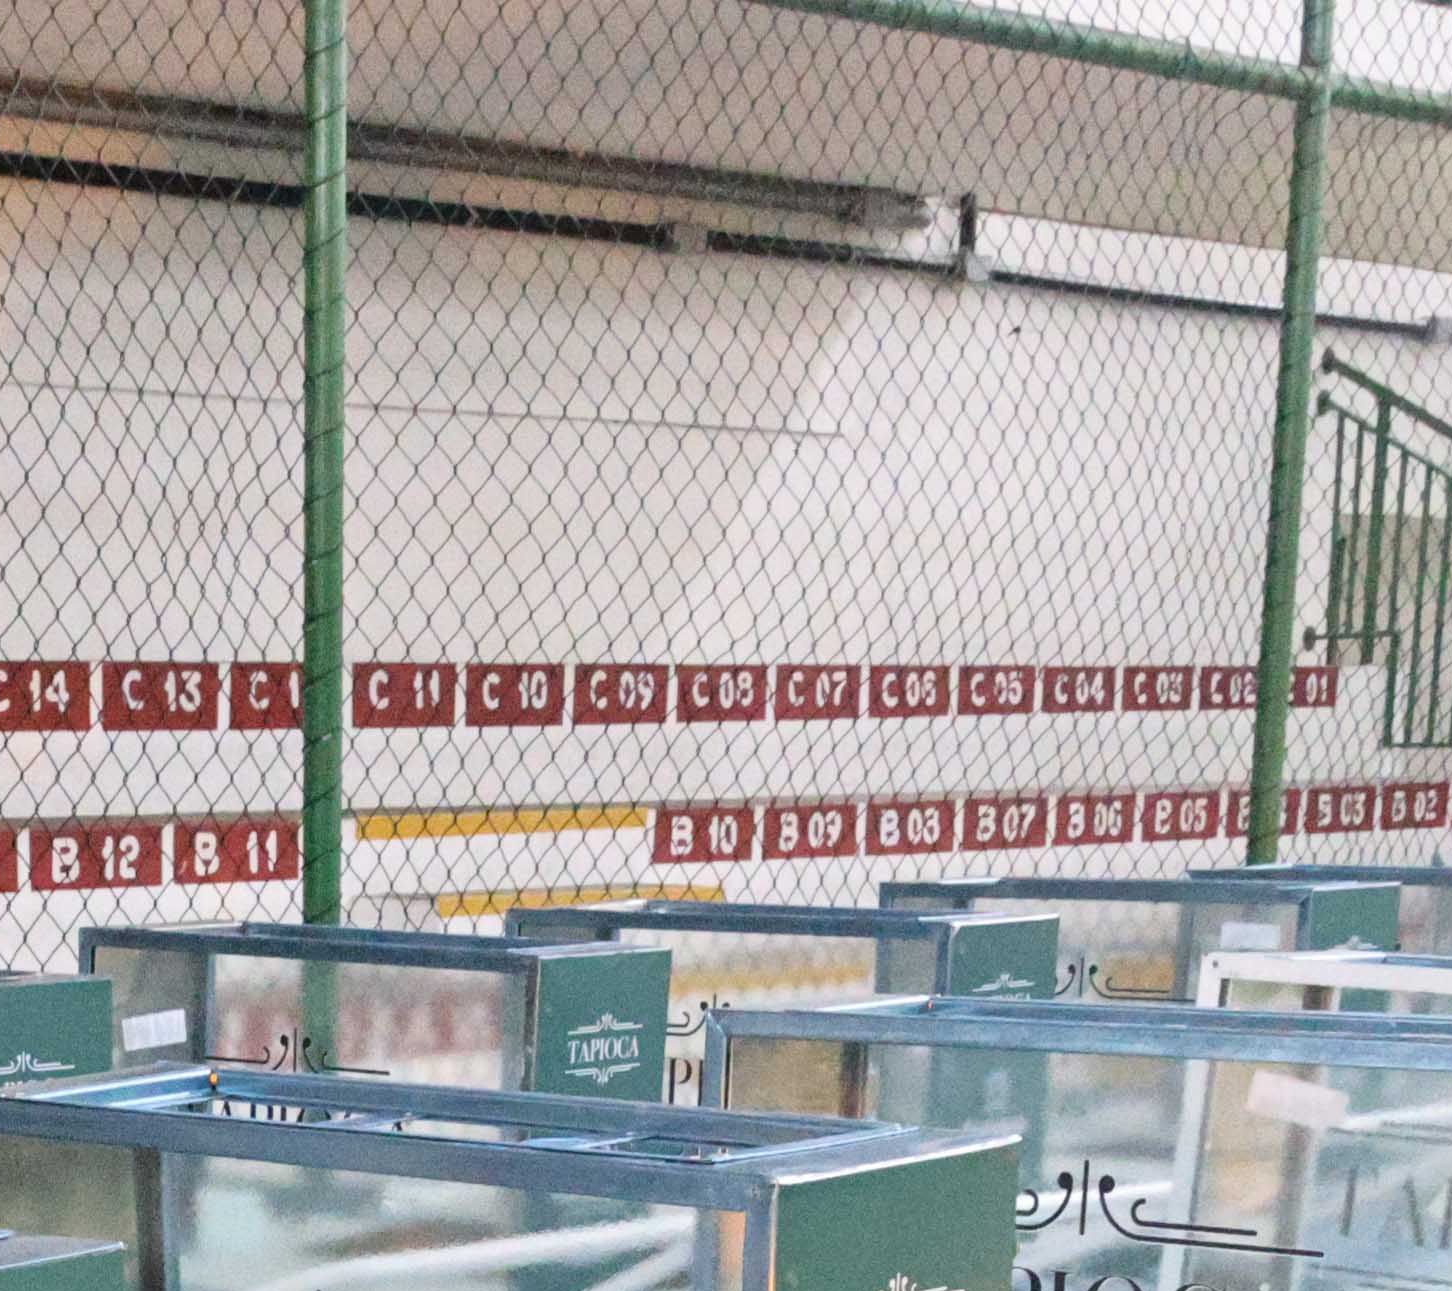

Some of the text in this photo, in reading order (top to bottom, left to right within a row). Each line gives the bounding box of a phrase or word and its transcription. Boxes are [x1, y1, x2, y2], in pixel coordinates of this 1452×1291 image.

[30, 670, 69, 712] 14
[122, 670, 201, 712] C 13
[249, 671, 269, 709] C
[369, 670, 439, 709] C 11
[483, 671, 547, 709] C 10
[590, 670, 654, 710] C 09
[692, 671, 753, 708] C 08
[789, 671, 846, 707] C 07
[52, 835, 139, 883] B 12
[247, 830, 277, 873] 11
[567, 1032, 639, 1064] TAPIOCA
